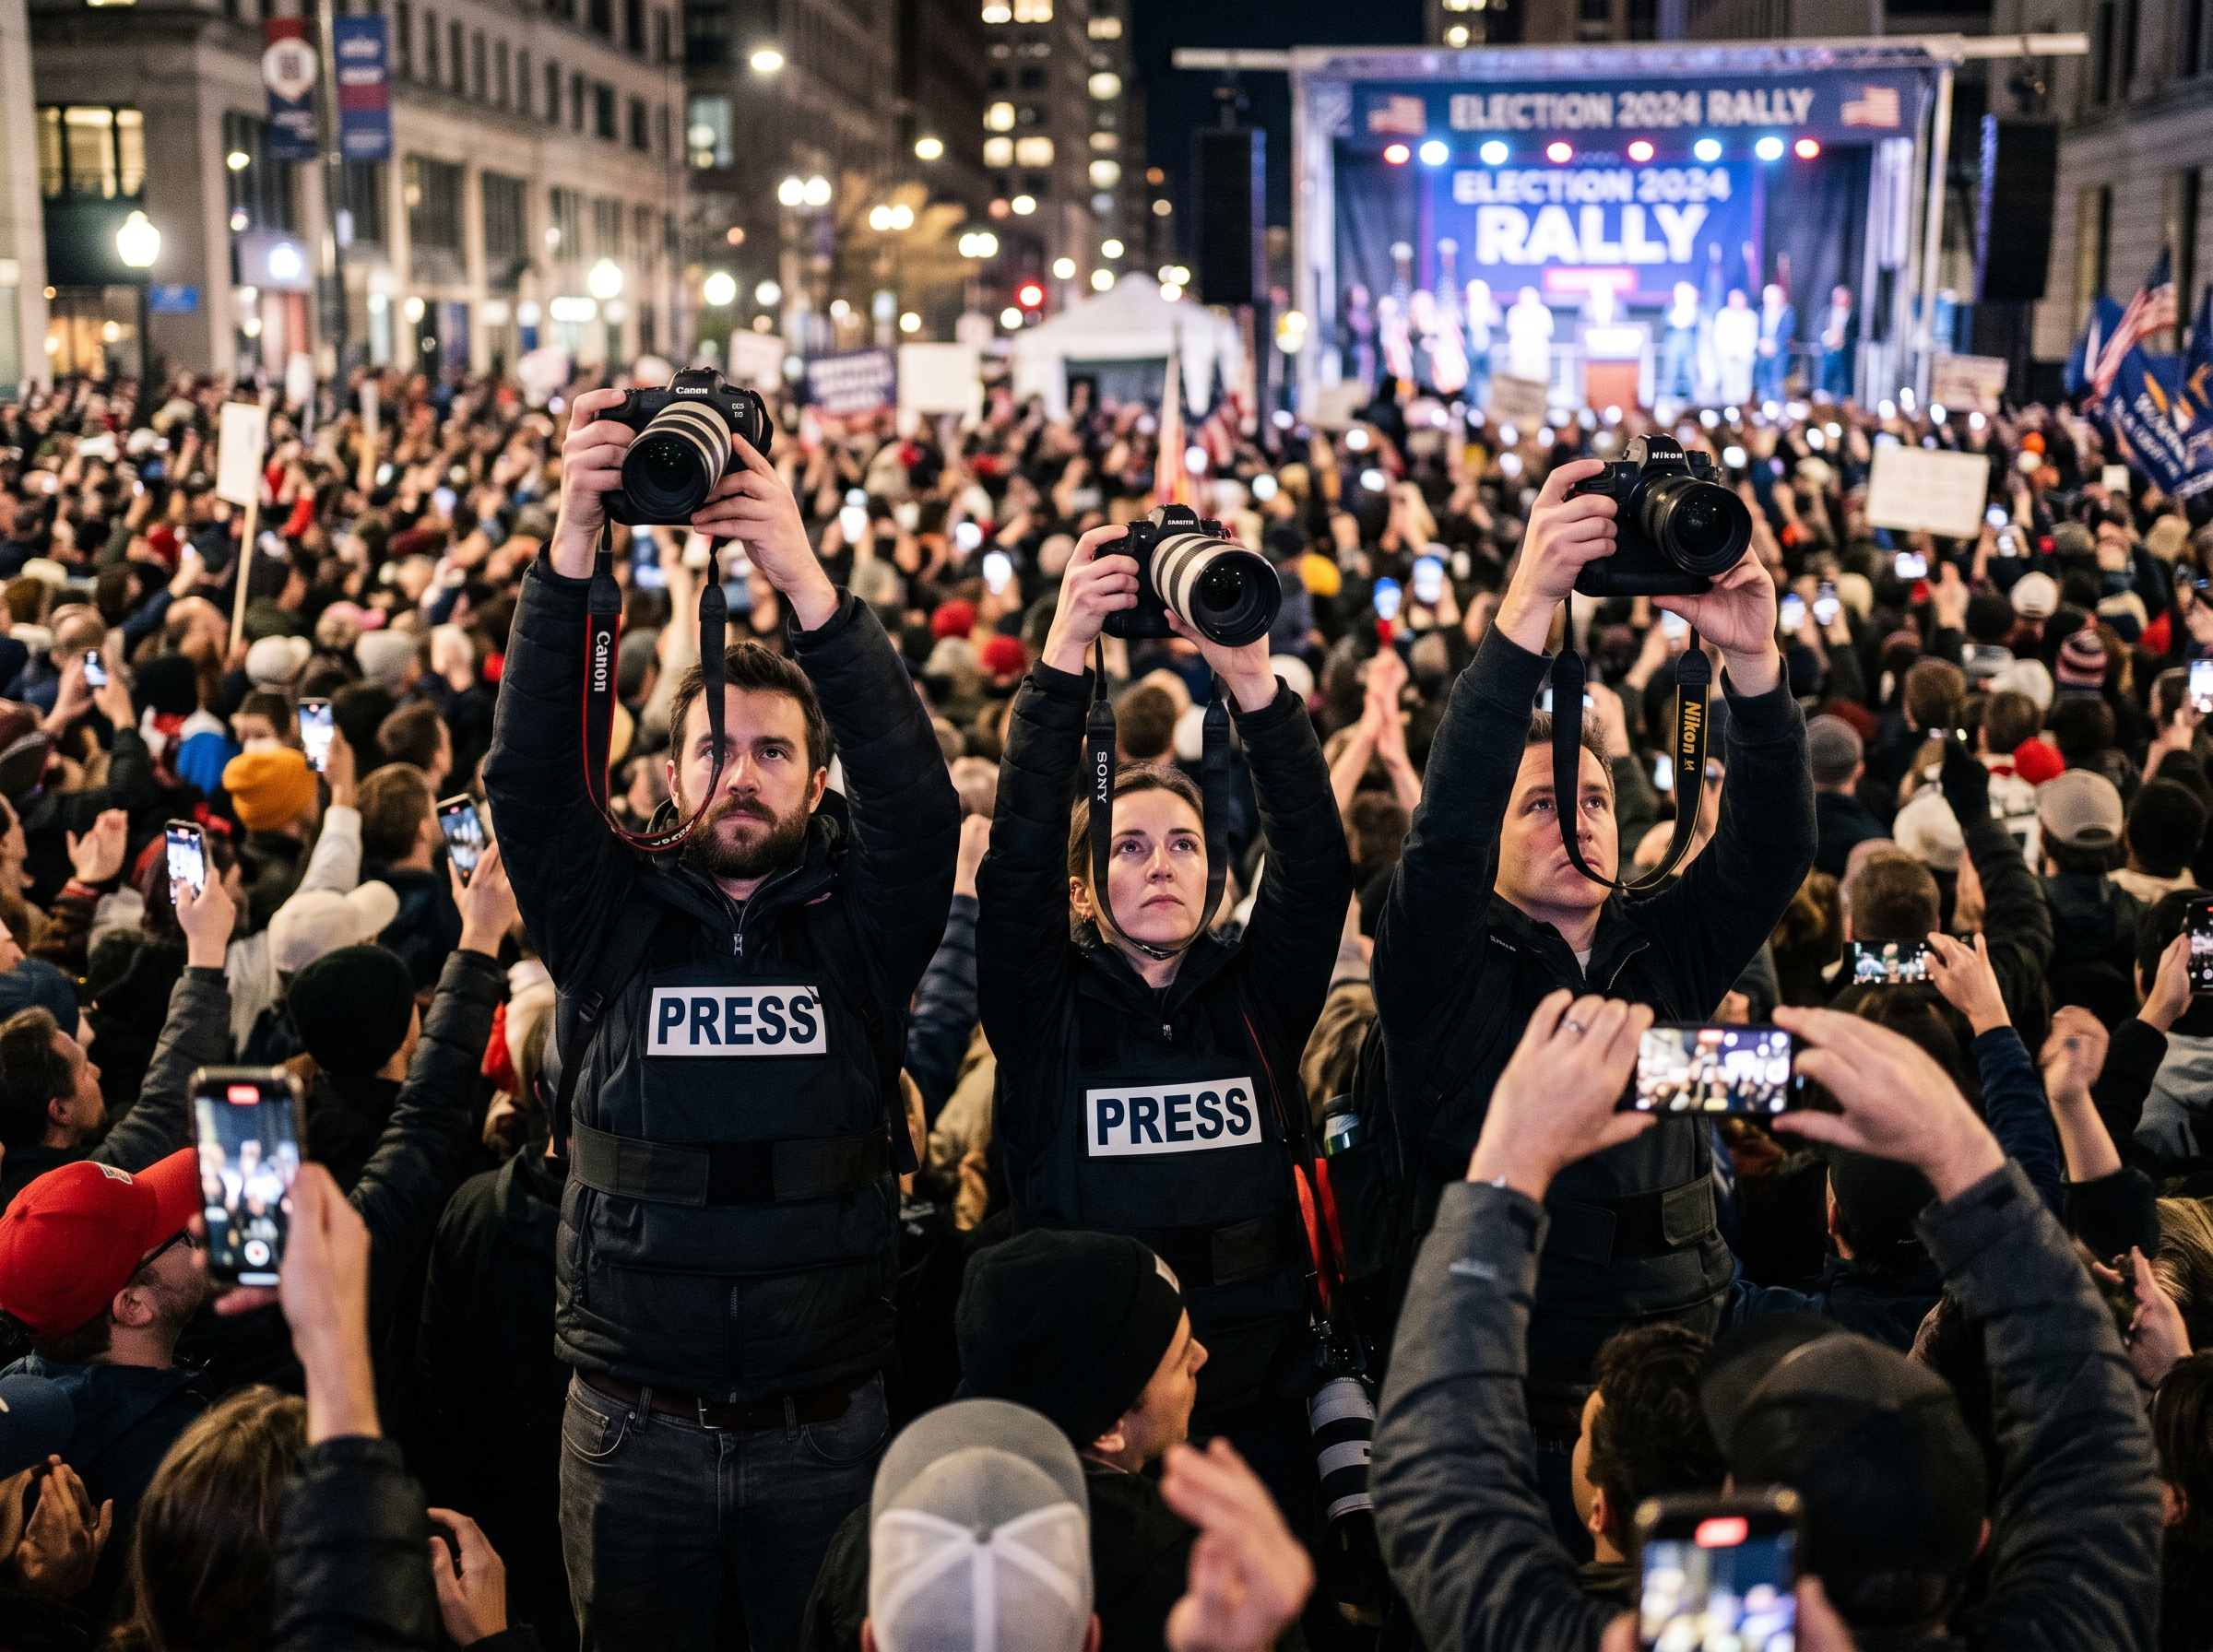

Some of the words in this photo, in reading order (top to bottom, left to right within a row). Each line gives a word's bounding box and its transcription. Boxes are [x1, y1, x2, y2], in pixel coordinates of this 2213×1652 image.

[1450, 93, 1614, 131] ELECTION
[1617, 90, 1702, 128] 2024
[1707, 88, 1815, 126] RALLY
[1452, 169, 1634, 205] ELECTION
[1637, 167, 1732, 203] 2024
[1476, 202, 1710, 265] RALLY
[594, 631, 611, 692] Canon
[1683, 701, 1702, 754] Nikon
[1096, 751, 1107, 803] SONY
[657, 995, 817, 1044] PRESS
[1096, 1087, 1252, 1146] PRESS
